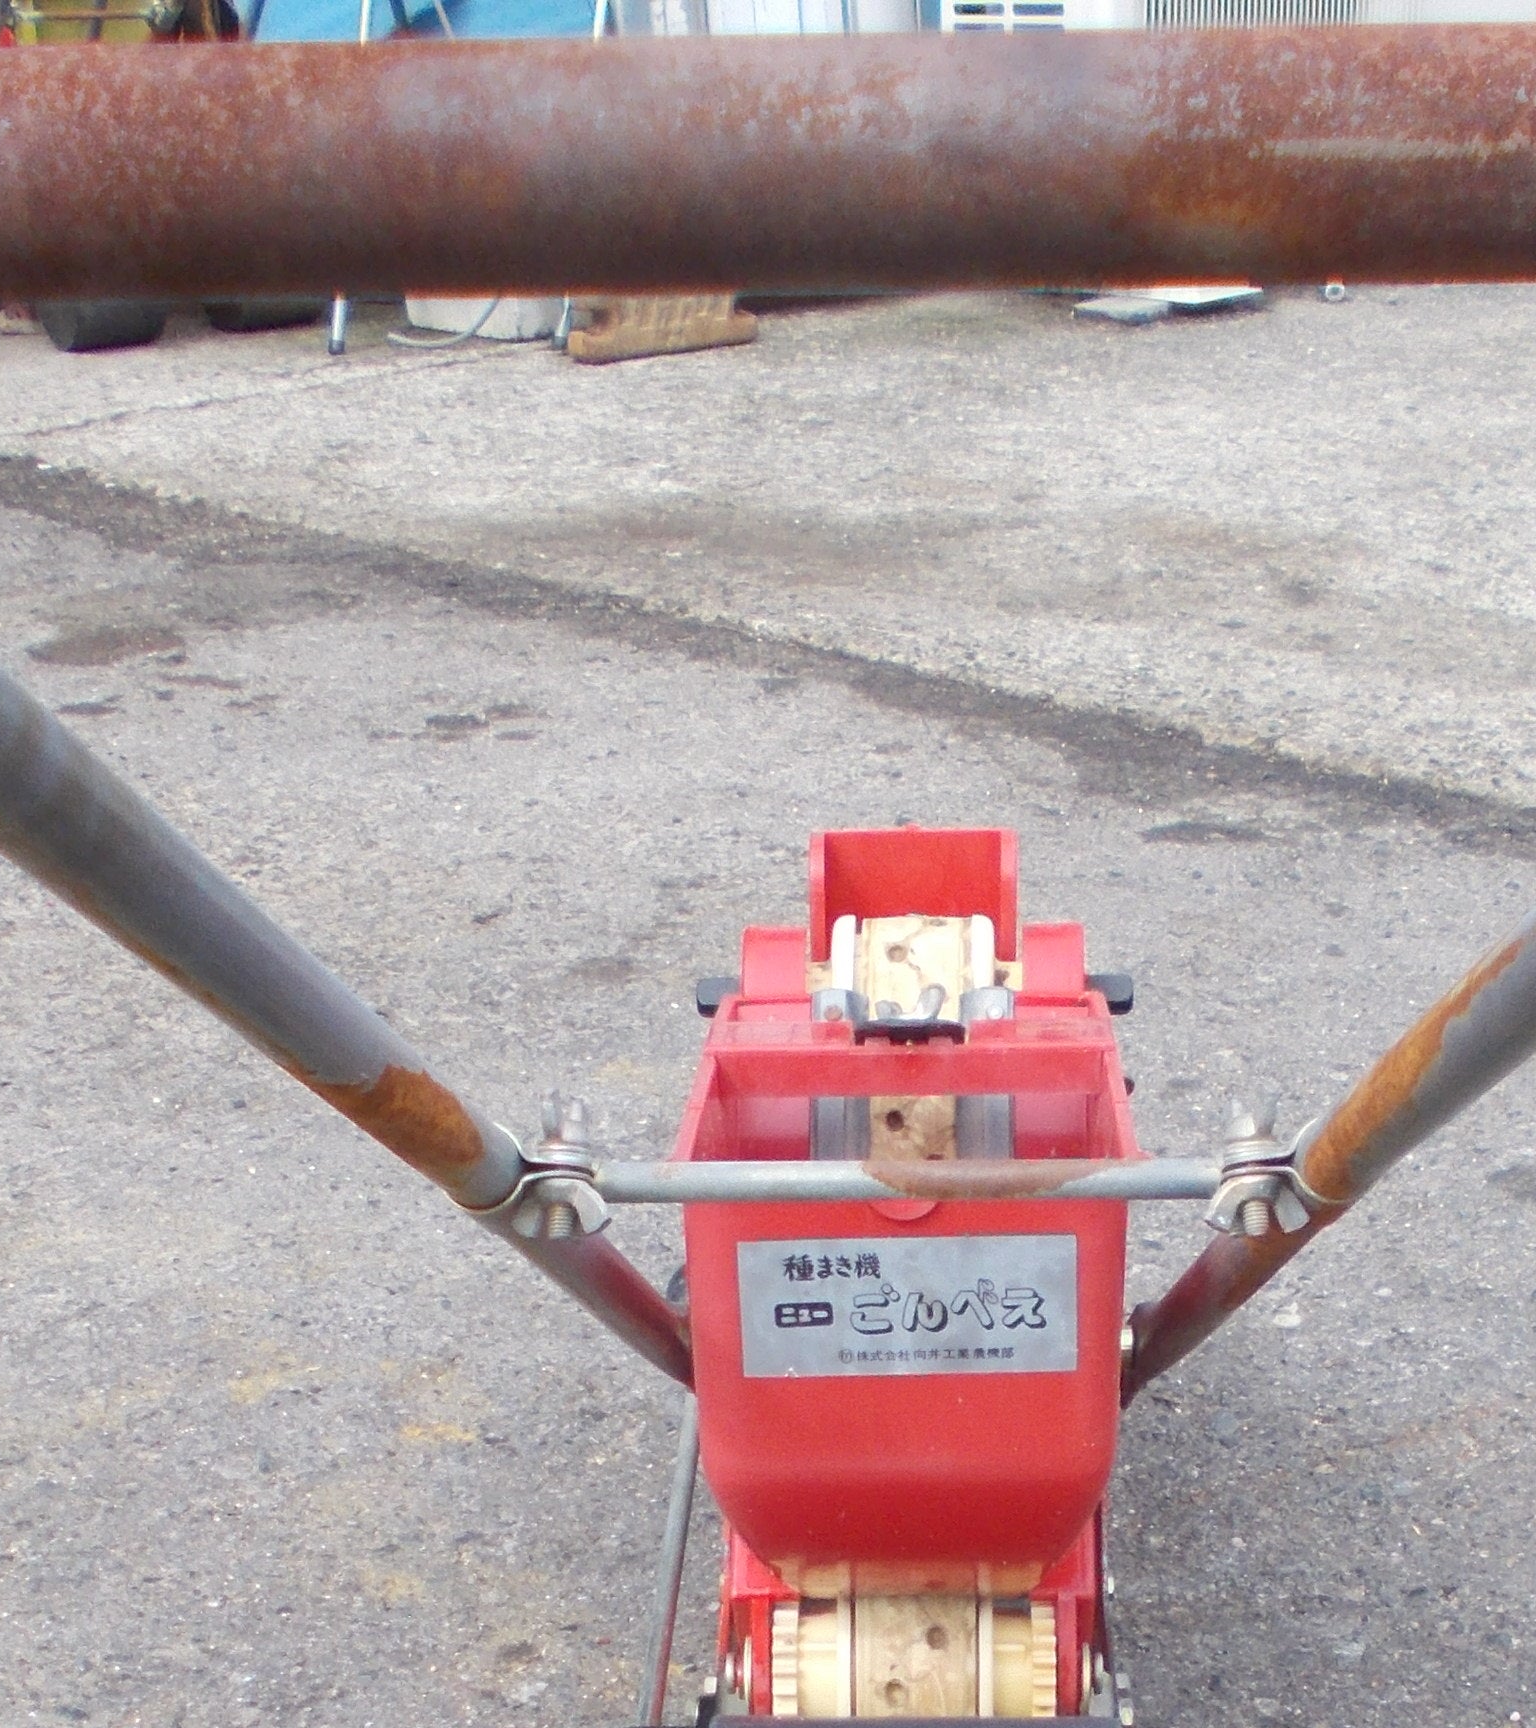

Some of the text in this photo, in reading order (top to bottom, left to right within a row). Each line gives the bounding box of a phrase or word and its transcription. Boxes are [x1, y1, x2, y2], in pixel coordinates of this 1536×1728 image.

[782, 1253, 882, 1282] 種まき機
[777, 1278, 1048, 1336] ニュー ごんべえ
